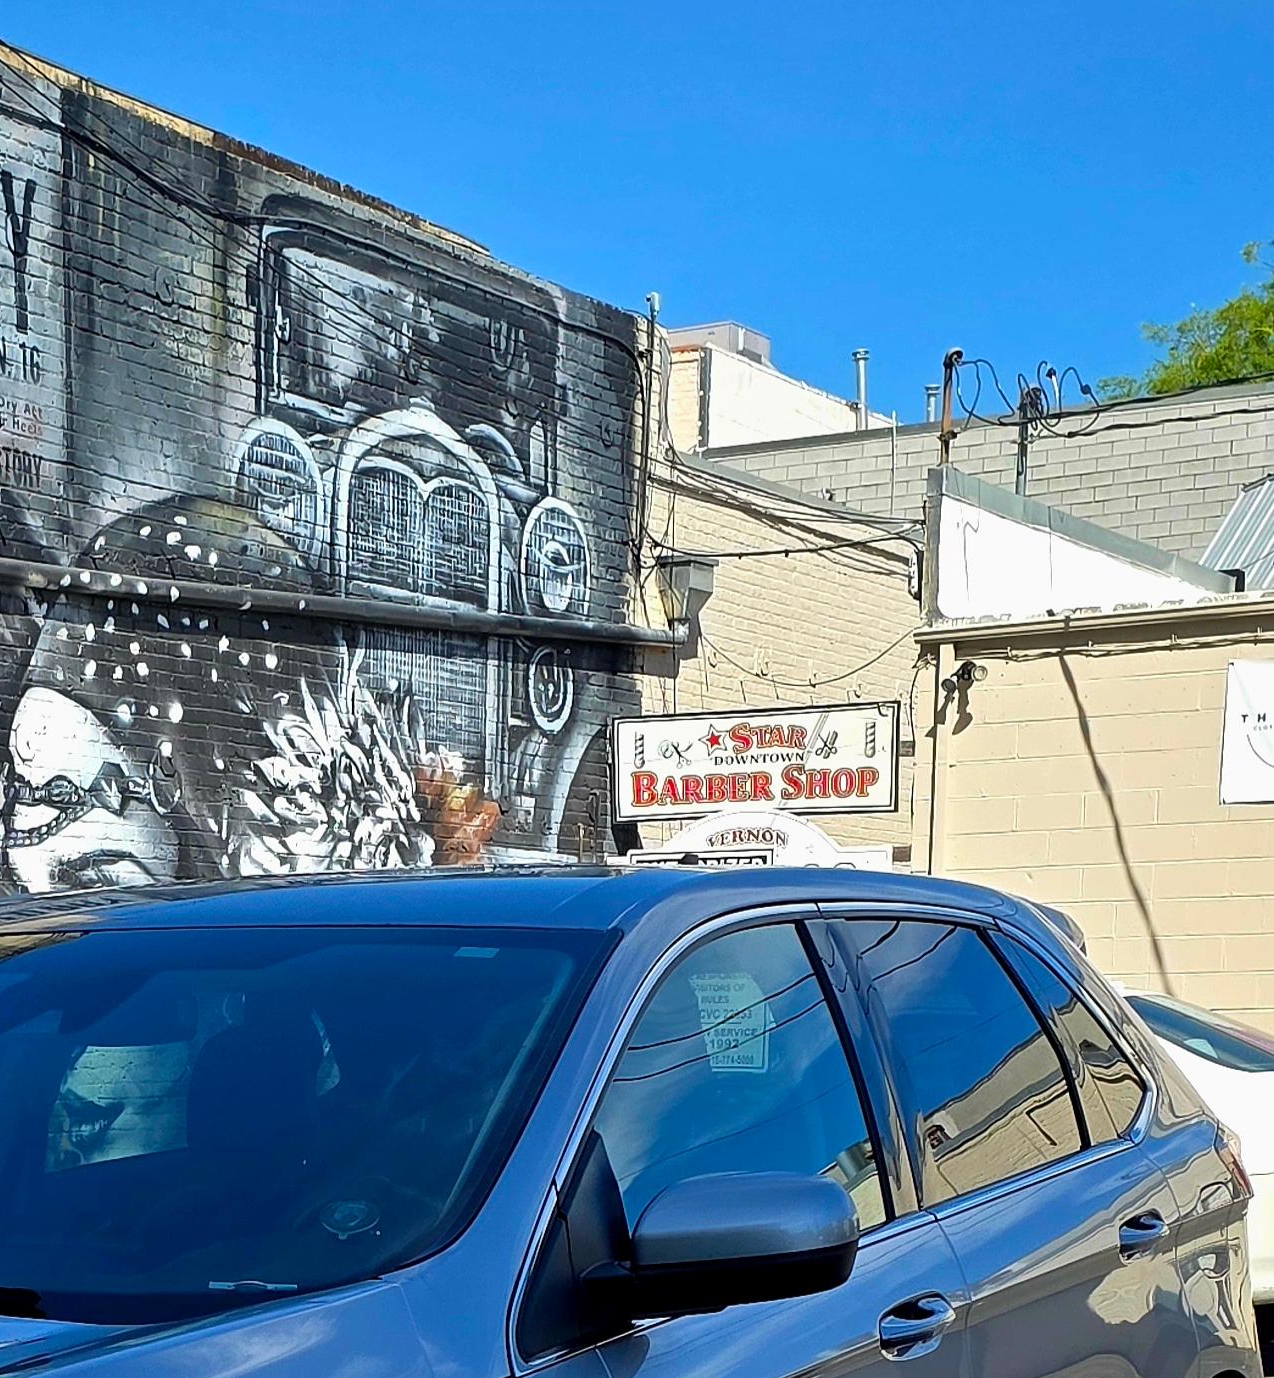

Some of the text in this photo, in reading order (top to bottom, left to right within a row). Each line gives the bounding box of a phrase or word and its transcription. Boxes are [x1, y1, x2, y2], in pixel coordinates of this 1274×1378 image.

[17, 341, 43, 386] 16
[23, 405, 43, 420] Act
[728, 722, 809, 754] STAR
[713, 750, 807, 766] DOWNTOWN
[630, 763, 880, 808] BARBER SHOP
[706, 827, 789, 848] VERNON
[713, 1027, 758, 1038] SERVICE
